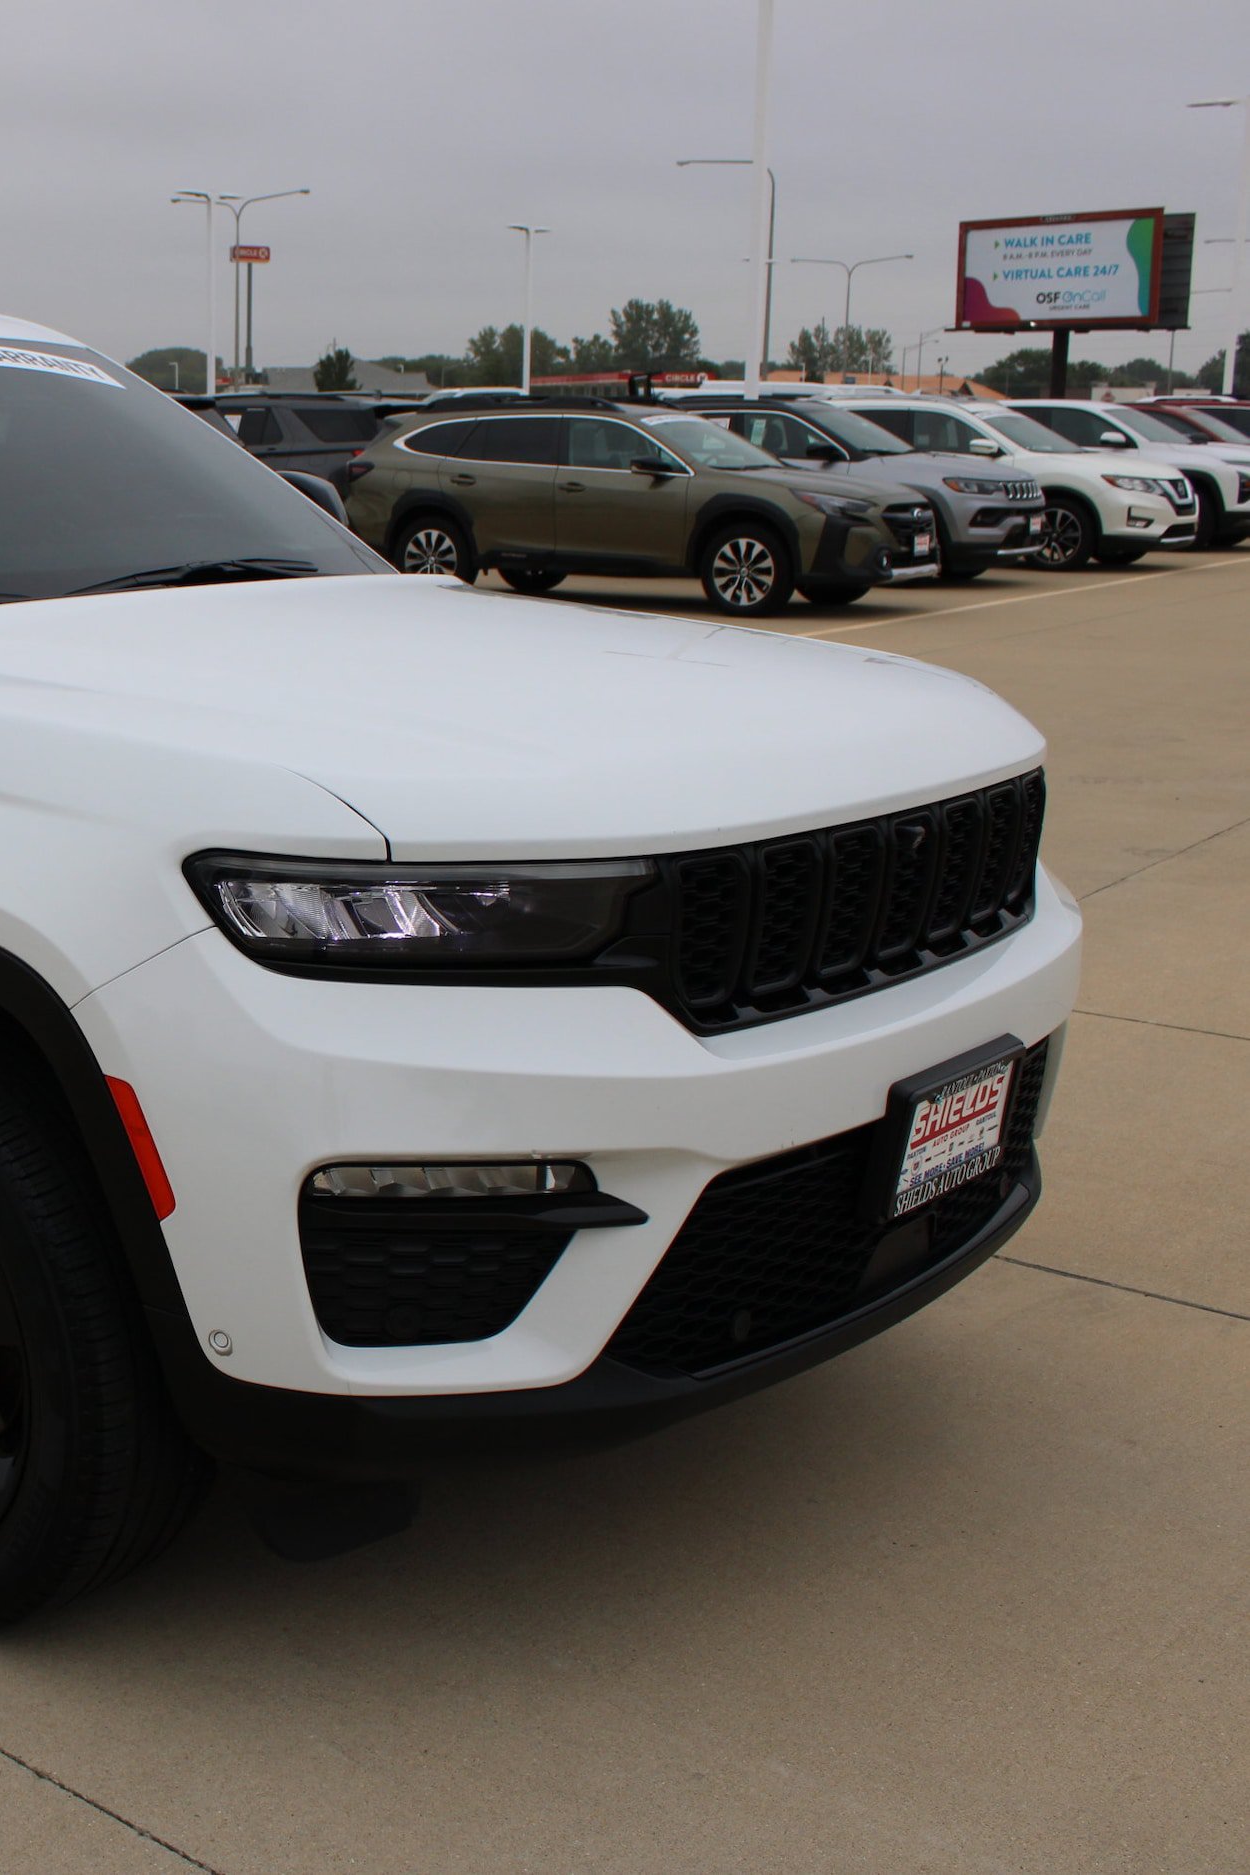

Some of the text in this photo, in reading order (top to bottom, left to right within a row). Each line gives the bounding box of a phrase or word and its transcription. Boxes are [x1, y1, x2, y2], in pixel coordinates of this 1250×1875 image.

[1004, 232, 1092, 249] WALK IN CARE
[1002, 263, 1120, 281] VIRTUAL CARE 24/7
[1036, 291, 1062, 305] OSF
[665, 373, 696, 383] CIRCLE
[910, 1074, 1006, 1142] SHIELDS
[933, 1123, 971, 1148] AUTO GROUP
[909, 1173, 923, 1187] SEE
[924, 1162, 944, 1178] MORE
[946, 1152, 964, 1169] SAVE
[893, 1145, 1001, 1218] SHIELDS AUTO GROUP
